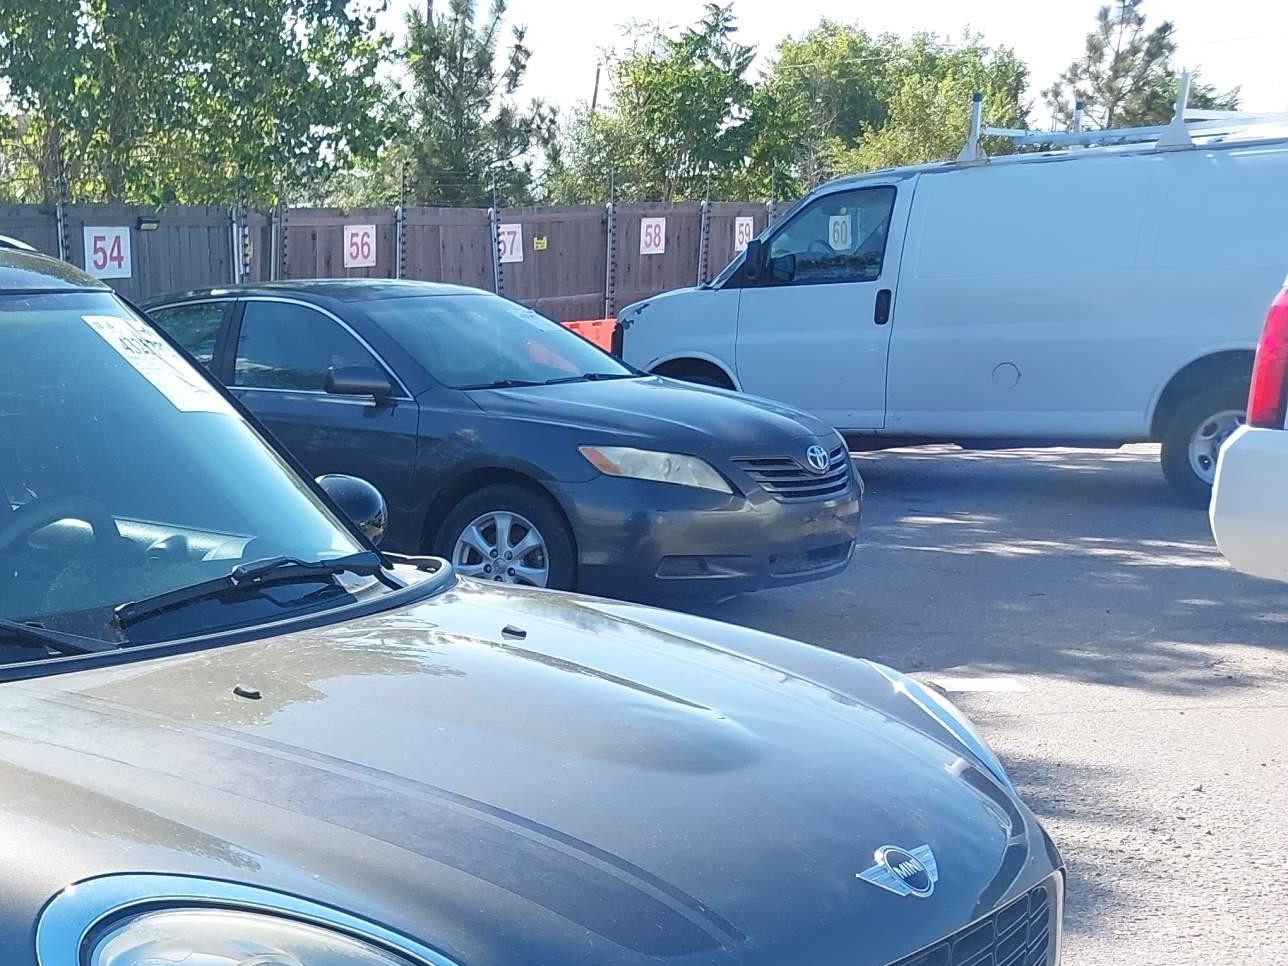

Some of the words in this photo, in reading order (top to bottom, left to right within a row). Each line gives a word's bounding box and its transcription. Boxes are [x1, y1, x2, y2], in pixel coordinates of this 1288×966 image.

[645, 224, 662, 248] 58
[738, 224, 751, 245] 59
[832, 221, 848, 244] 60
[93, 235, 124, 270] 54
[349, 232, 371, 260] 56
[893, 859, 924, 879] MINI
